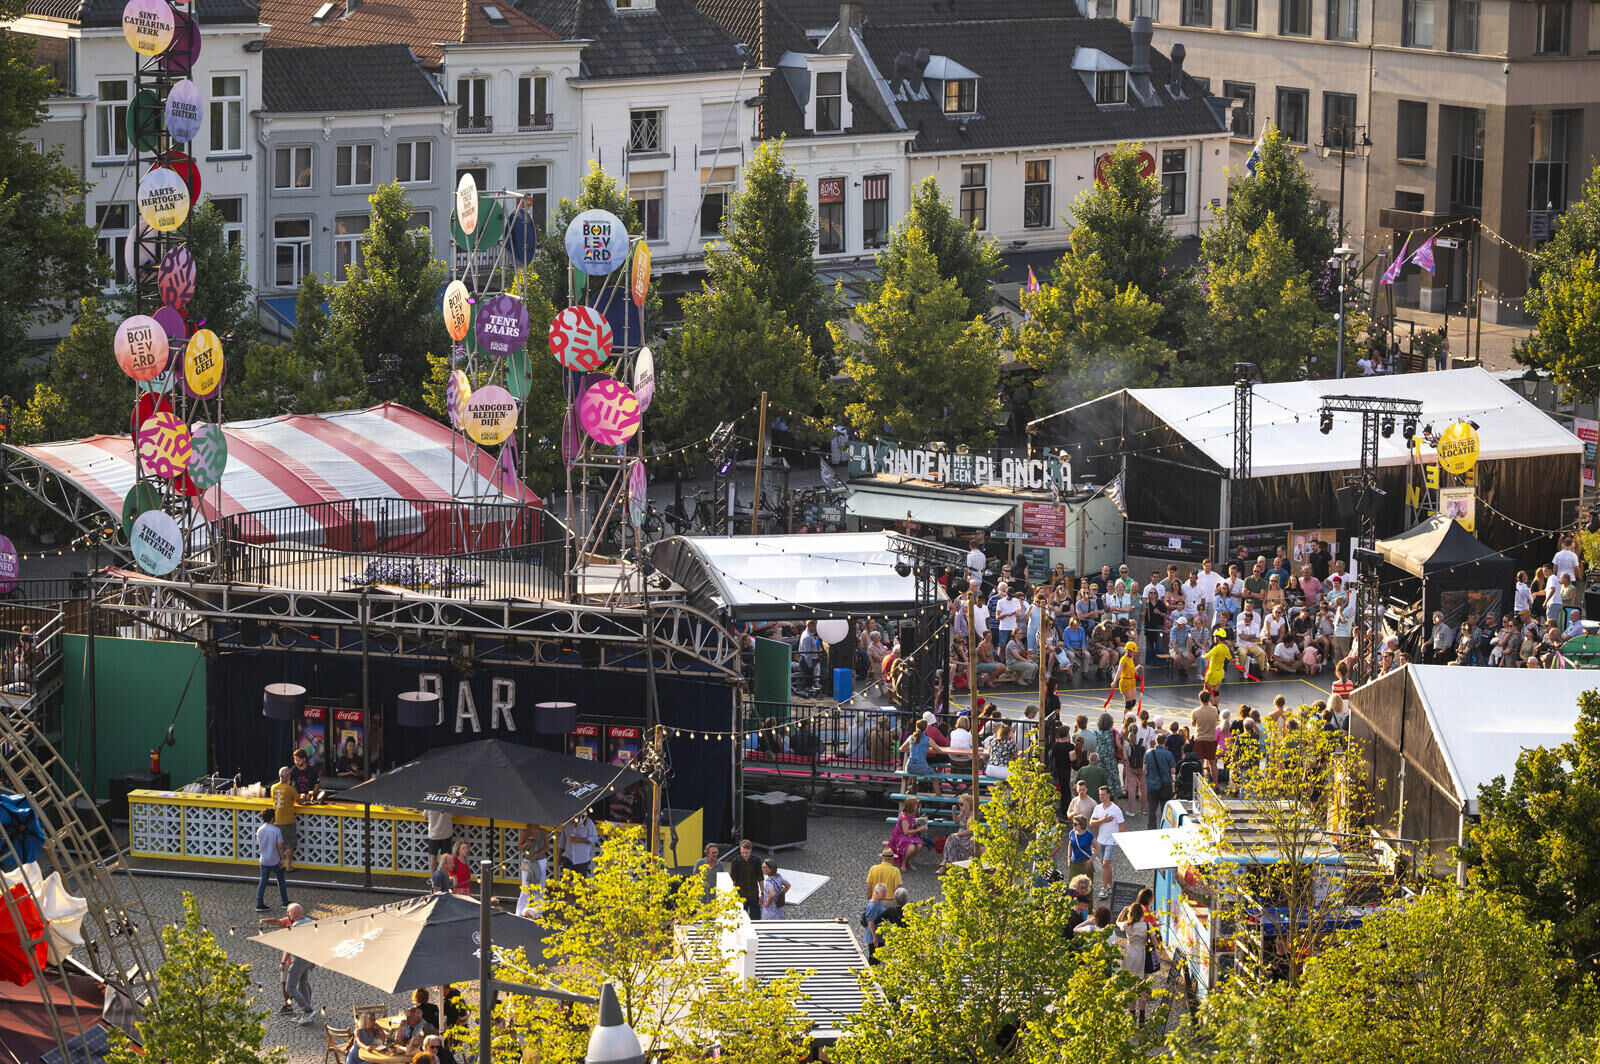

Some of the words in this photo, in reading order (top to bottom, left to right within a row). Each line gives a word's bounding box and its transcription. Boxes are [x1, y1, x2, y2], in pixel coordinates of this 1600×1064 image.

[139, 11, 160, 20] SINT-
[124, 16, 173, 31] CATHARINA-
[137, 26, 159, 37] KERK
[149, 187, 176, 197] AARTS-
[141, 193, 186, 206] HERTOGEN-
[154, 202, 175, 212] LAAN
[490, 315, 518, 328] TENT
[484, 323, 520, 337] PAARS
[194, 348, 213, 366] TENT
[195, 359, 215, 375] GEEL
[468, 404, 513, 412] LANDGOED
[473, 411, 508, 419] BLEIJEN-
[481, 418, 500, 426] DIJK
[1442, 446, 1476, 458] LOCATIE
[954, 453, 971, 468] MET
[954, 468, 971, 483] EEN
[142, 524, 176, 553] THEATER
[138, 532, 173, 560] ARTEMIS
[337, 711, 360, 720] Coca-Cola
[612, 728, 635, 737] Coca-Cola
[424, 793, 457, 804] Hertog
